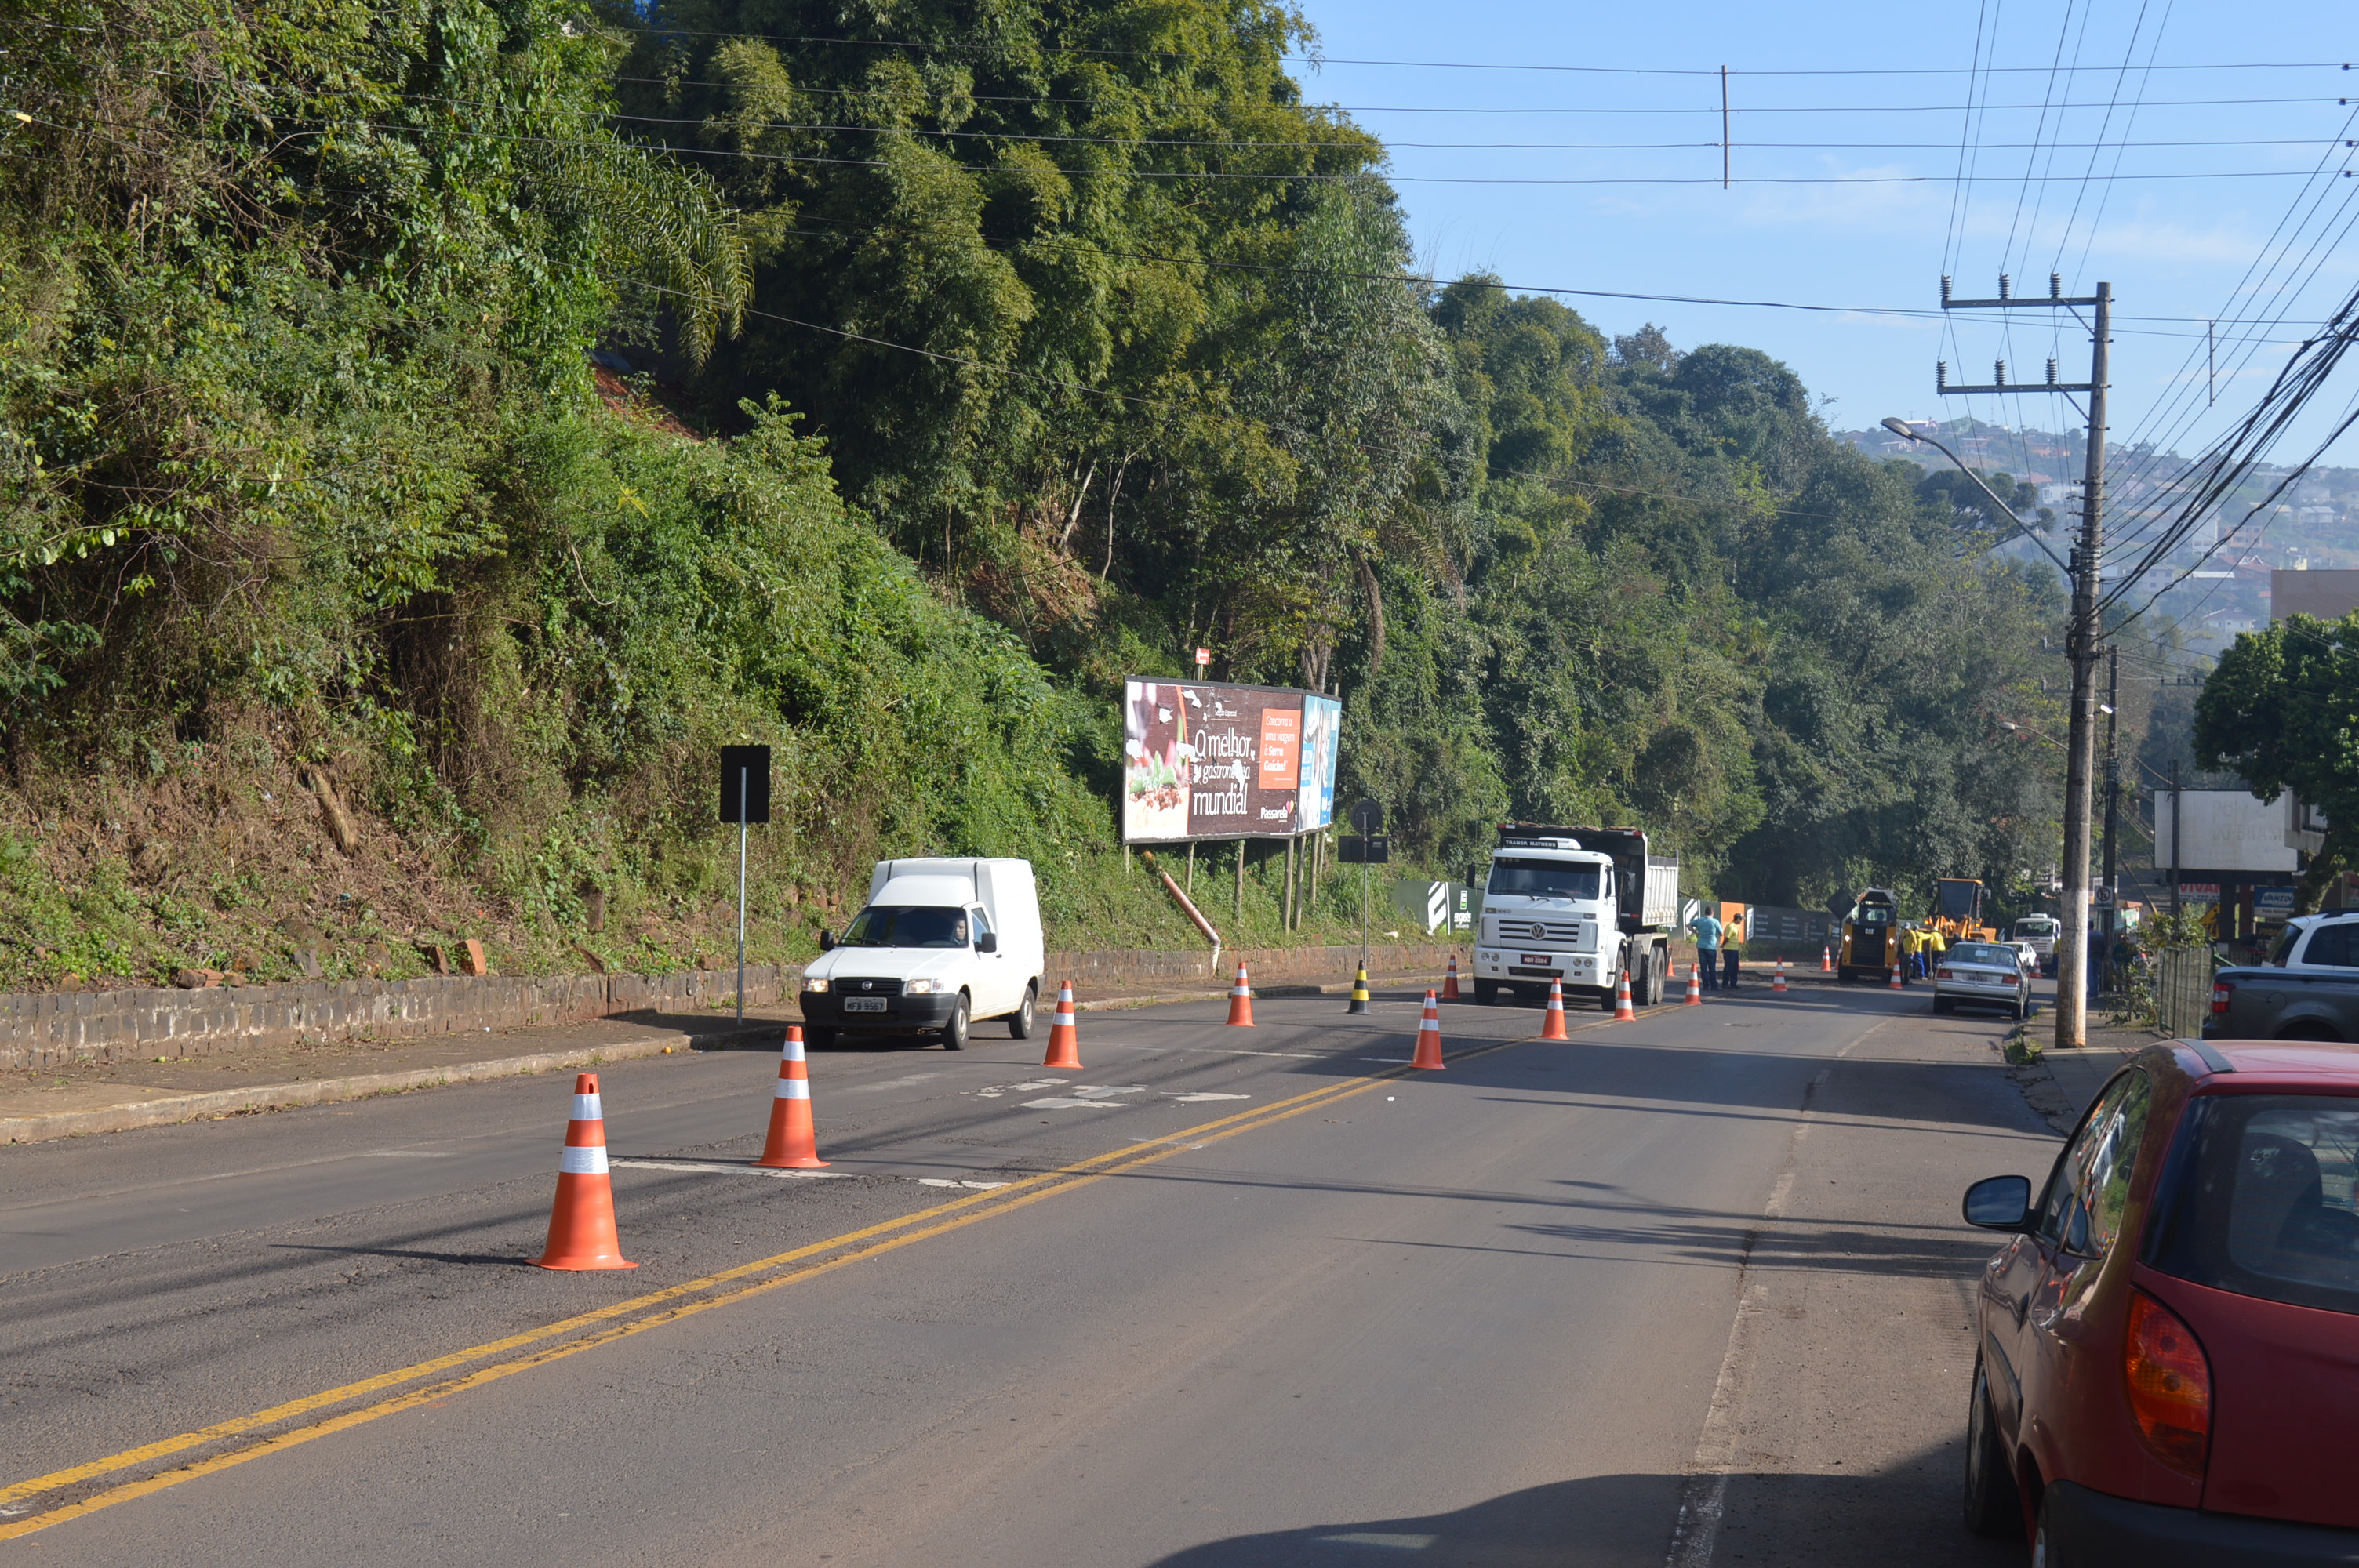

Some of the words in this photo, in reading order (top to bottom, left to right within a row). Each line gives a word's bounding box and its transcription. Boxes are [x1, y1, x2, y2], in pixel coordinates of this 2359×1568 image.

[1266, 715, 1289, 726] Concorra
[1194, 729, 1206, 758] O
[1208, 727, 1252, 758] melhor
[1265, 732, 1277, 741] uma
[1277, 731, 1296, 744] viagem
[1269, 746, 1284, 757] Serra
[1193, 782, 1249, 816] mundial
[1260, 805, 1288, 820] Passarela
